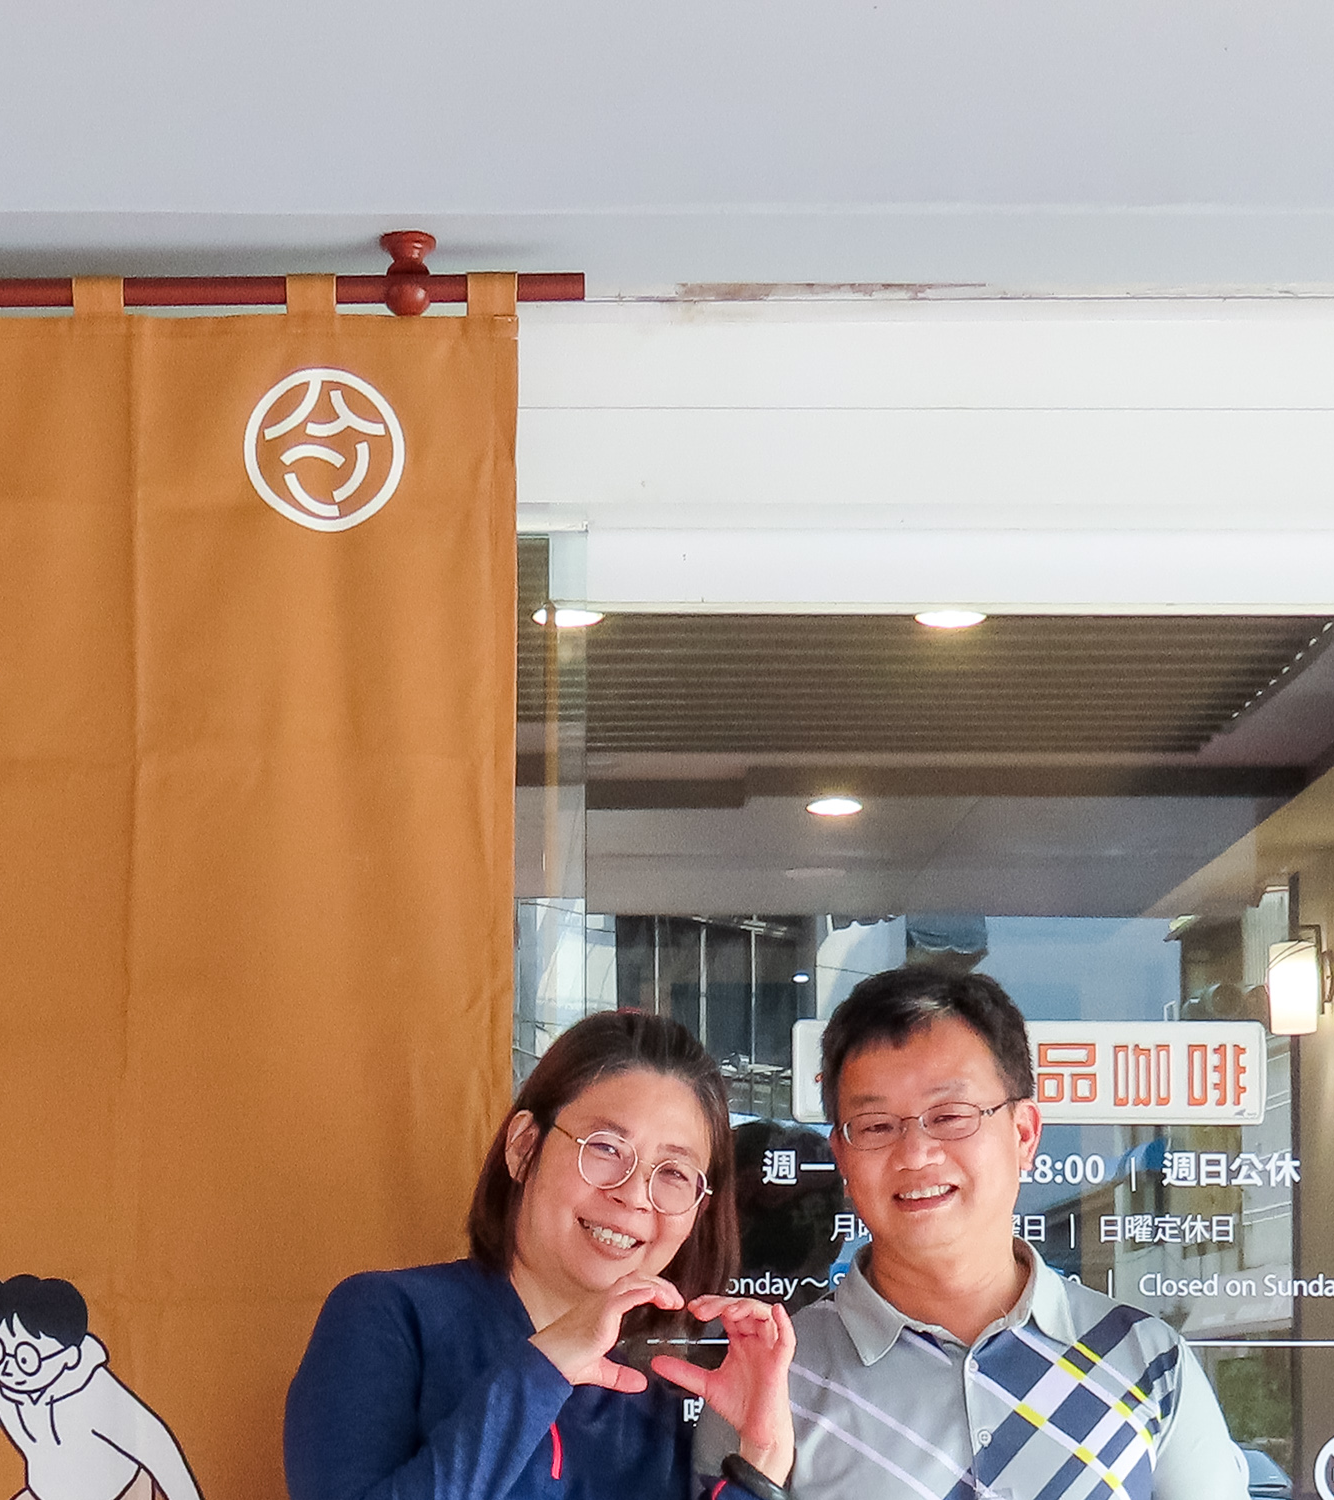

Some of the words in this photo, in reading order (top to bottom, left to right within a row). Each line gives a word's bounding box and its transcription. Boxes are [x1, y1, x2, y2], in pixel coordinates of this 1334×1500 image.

[1162, 1152, 1301, 1187] 週日公休
[1099, 1214, 1234, 1243] 日曜定休日
[1139, 1272, 1218, 1297] Closed
[1224, 1277, 1256, 1297] on
